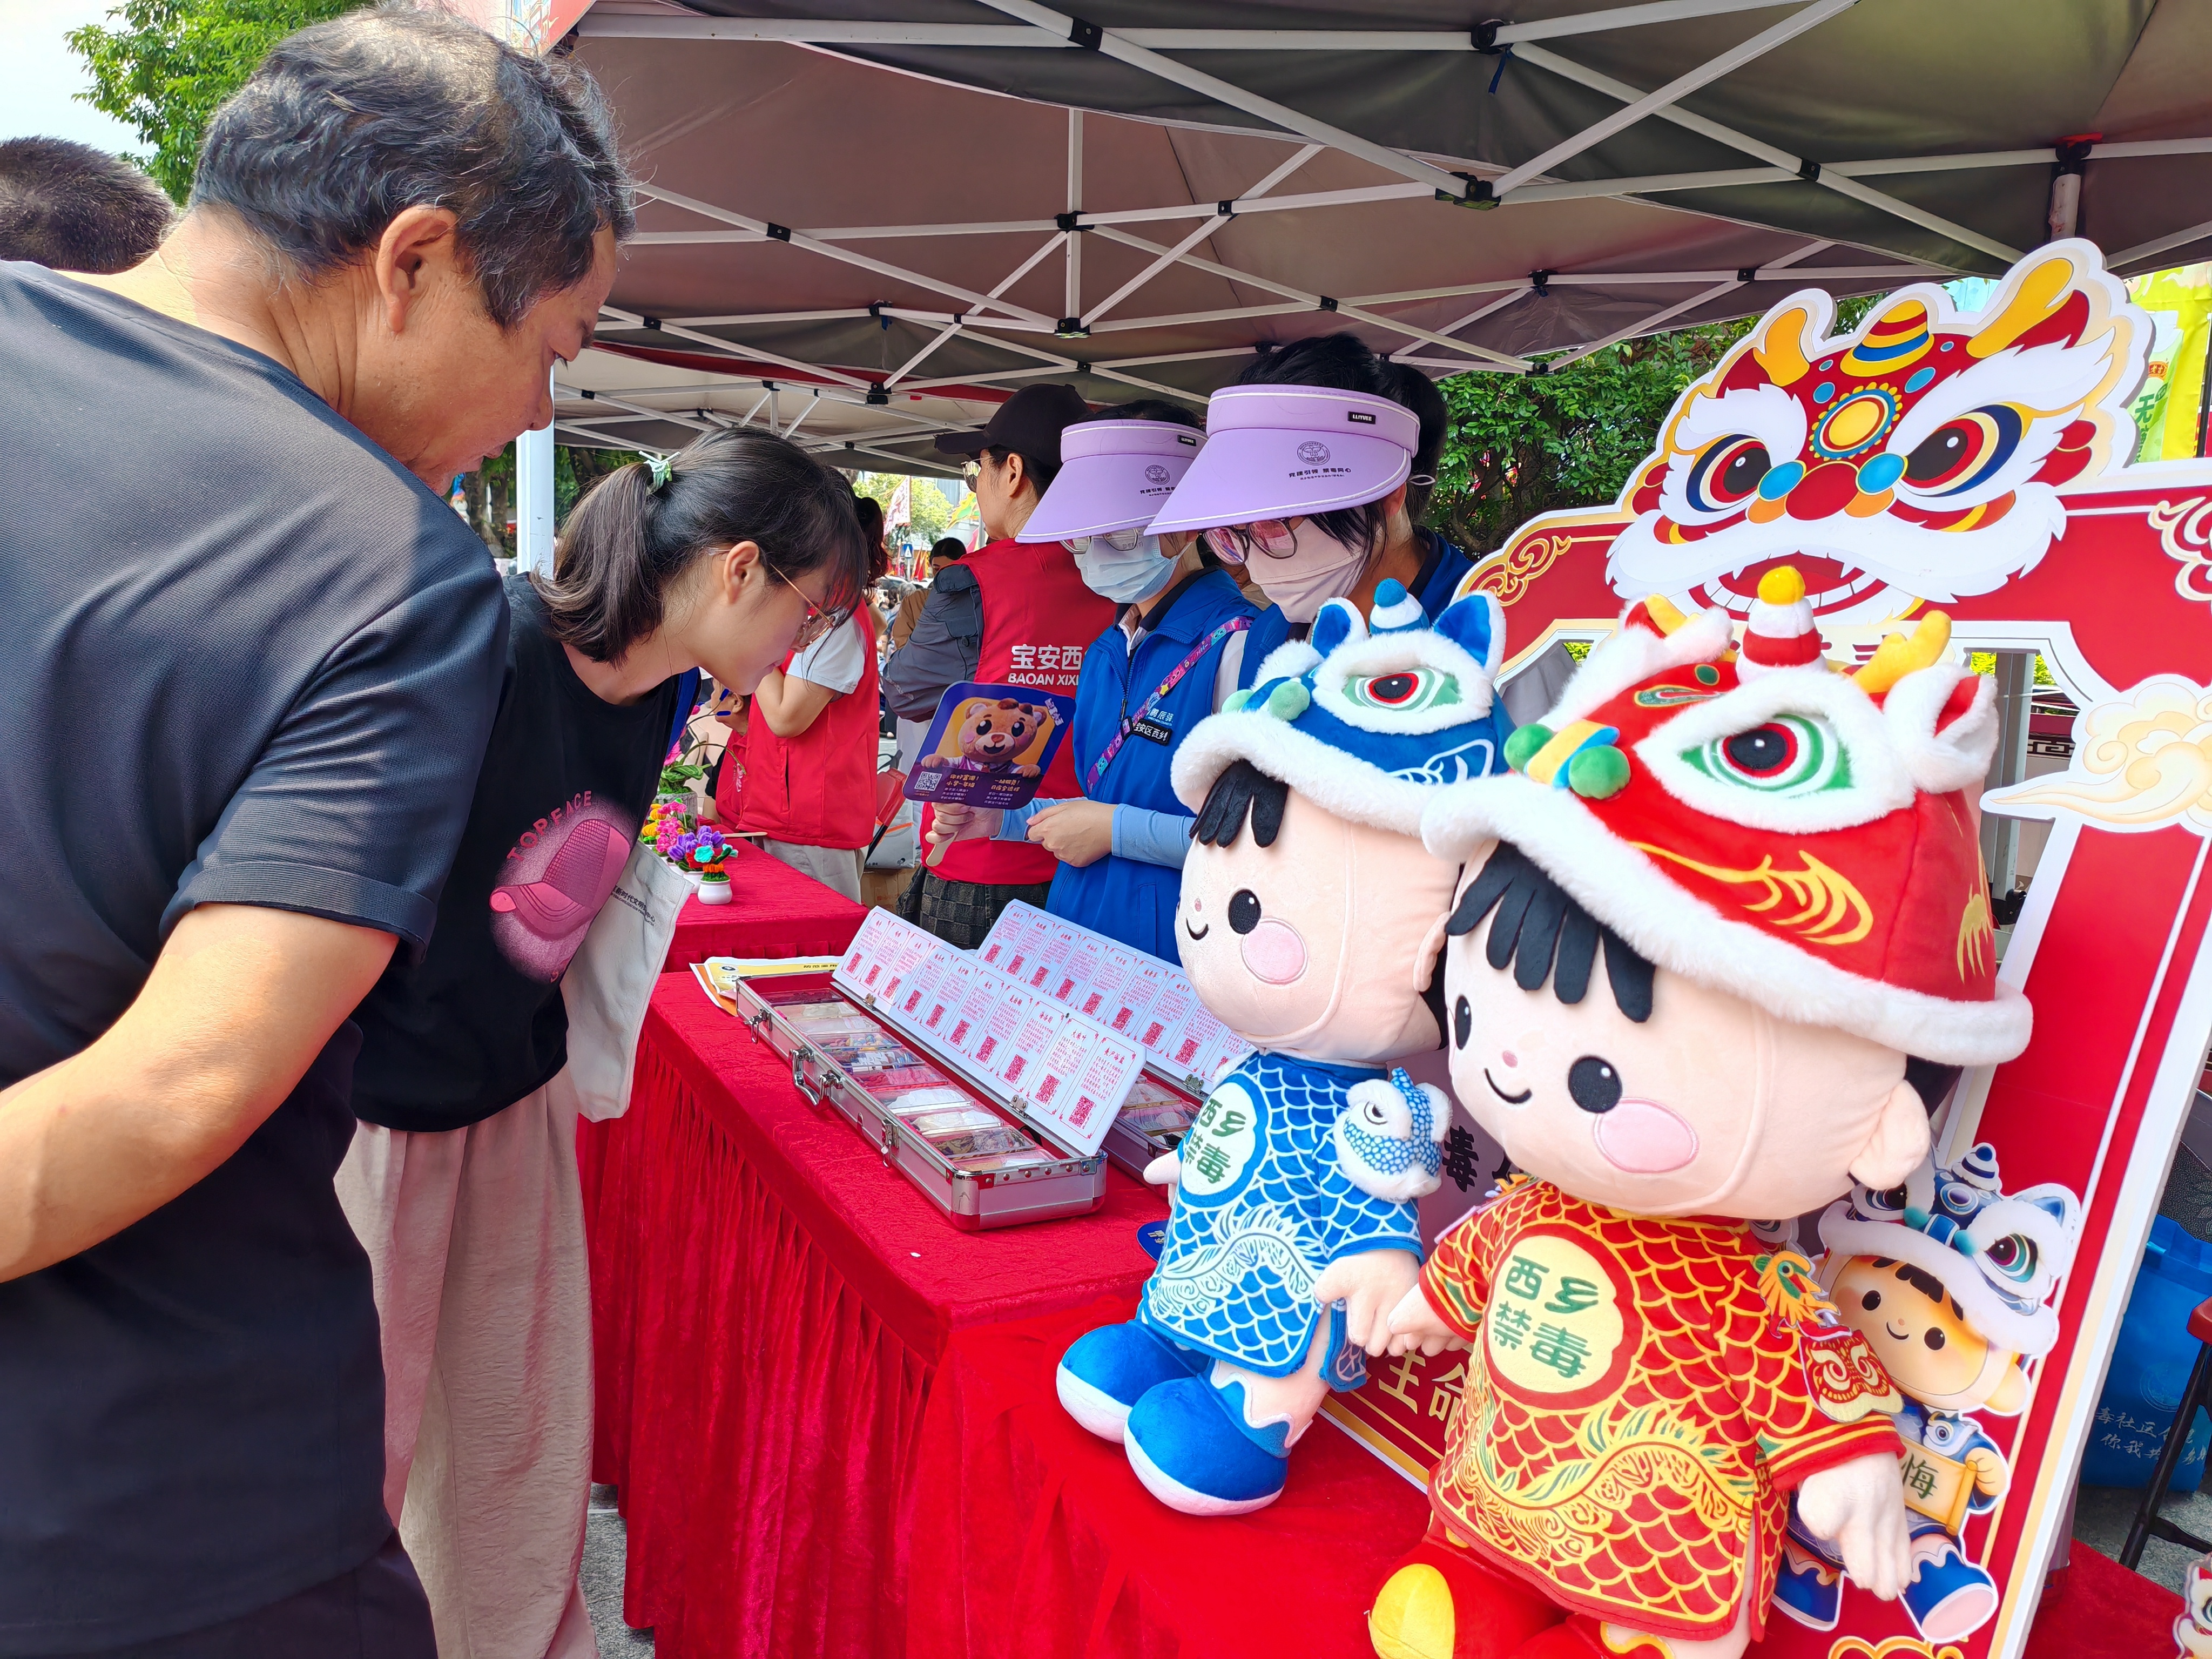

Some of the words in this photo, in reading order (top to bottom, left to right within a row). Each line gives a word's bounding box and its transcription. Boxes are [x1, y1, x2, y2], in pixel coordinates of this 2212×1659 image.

[2135, 394, 2155, 423] 无
[1008, 672, 1055, 685] BAOAN
[1010, 644, 1083, 670] 宝安西
[1199, 1098, 1246, 1137] 西乡
[1185, 1129, 1231, 1184] 禁毒
[1505, 1255, 1599, 1314] 西乡
[1493, 1301, 1593, 1379] 禁毒
[1900, 1452, 1940, 1500] 悔
